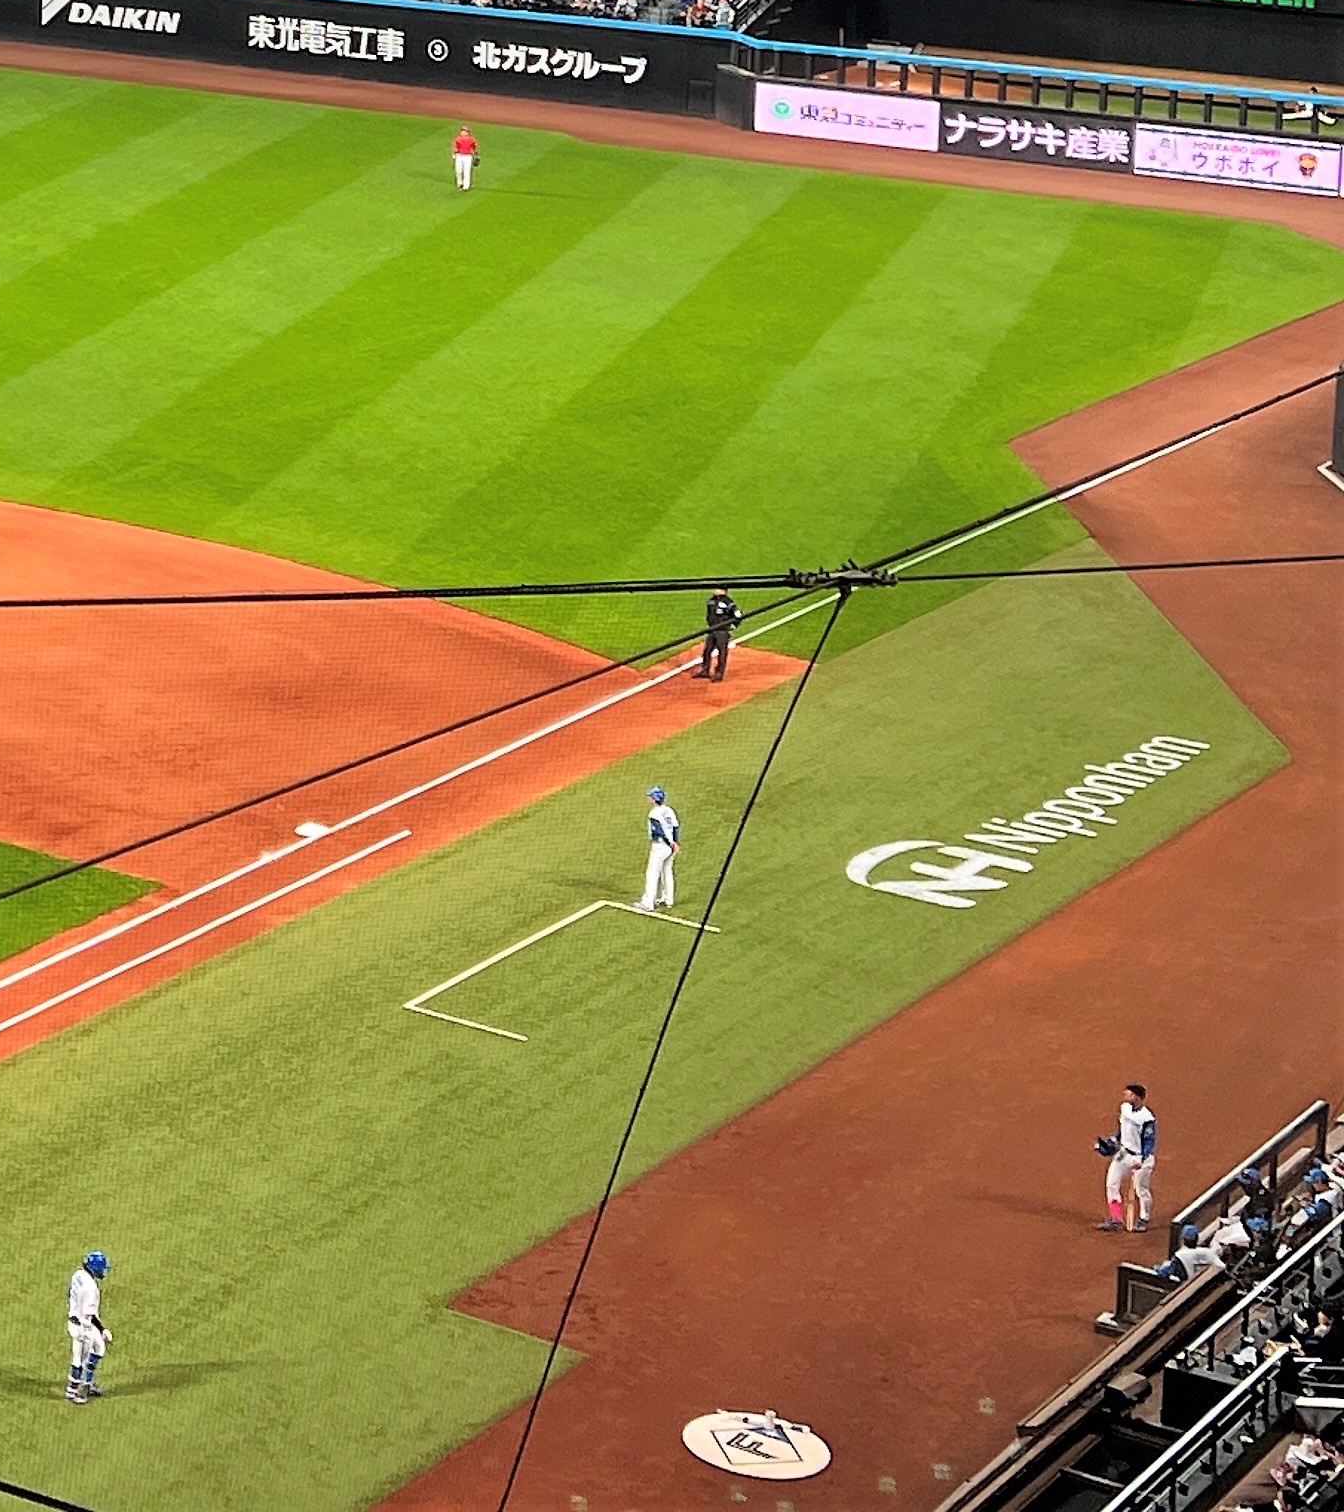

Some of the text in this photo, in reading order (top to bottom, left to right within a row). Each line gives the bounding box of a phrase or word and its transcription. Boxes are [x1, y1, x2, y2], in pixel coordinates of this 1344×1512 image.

[67, 2, 181, 33] DAIKIN
[248, 14, 405, 62] 東光電気工事
[472, 40, 648, 84] 北ガスグループ
[944, 113, 1131, 164] ナラサキ産業
[963, 734, 1210, 854] Nipponham
